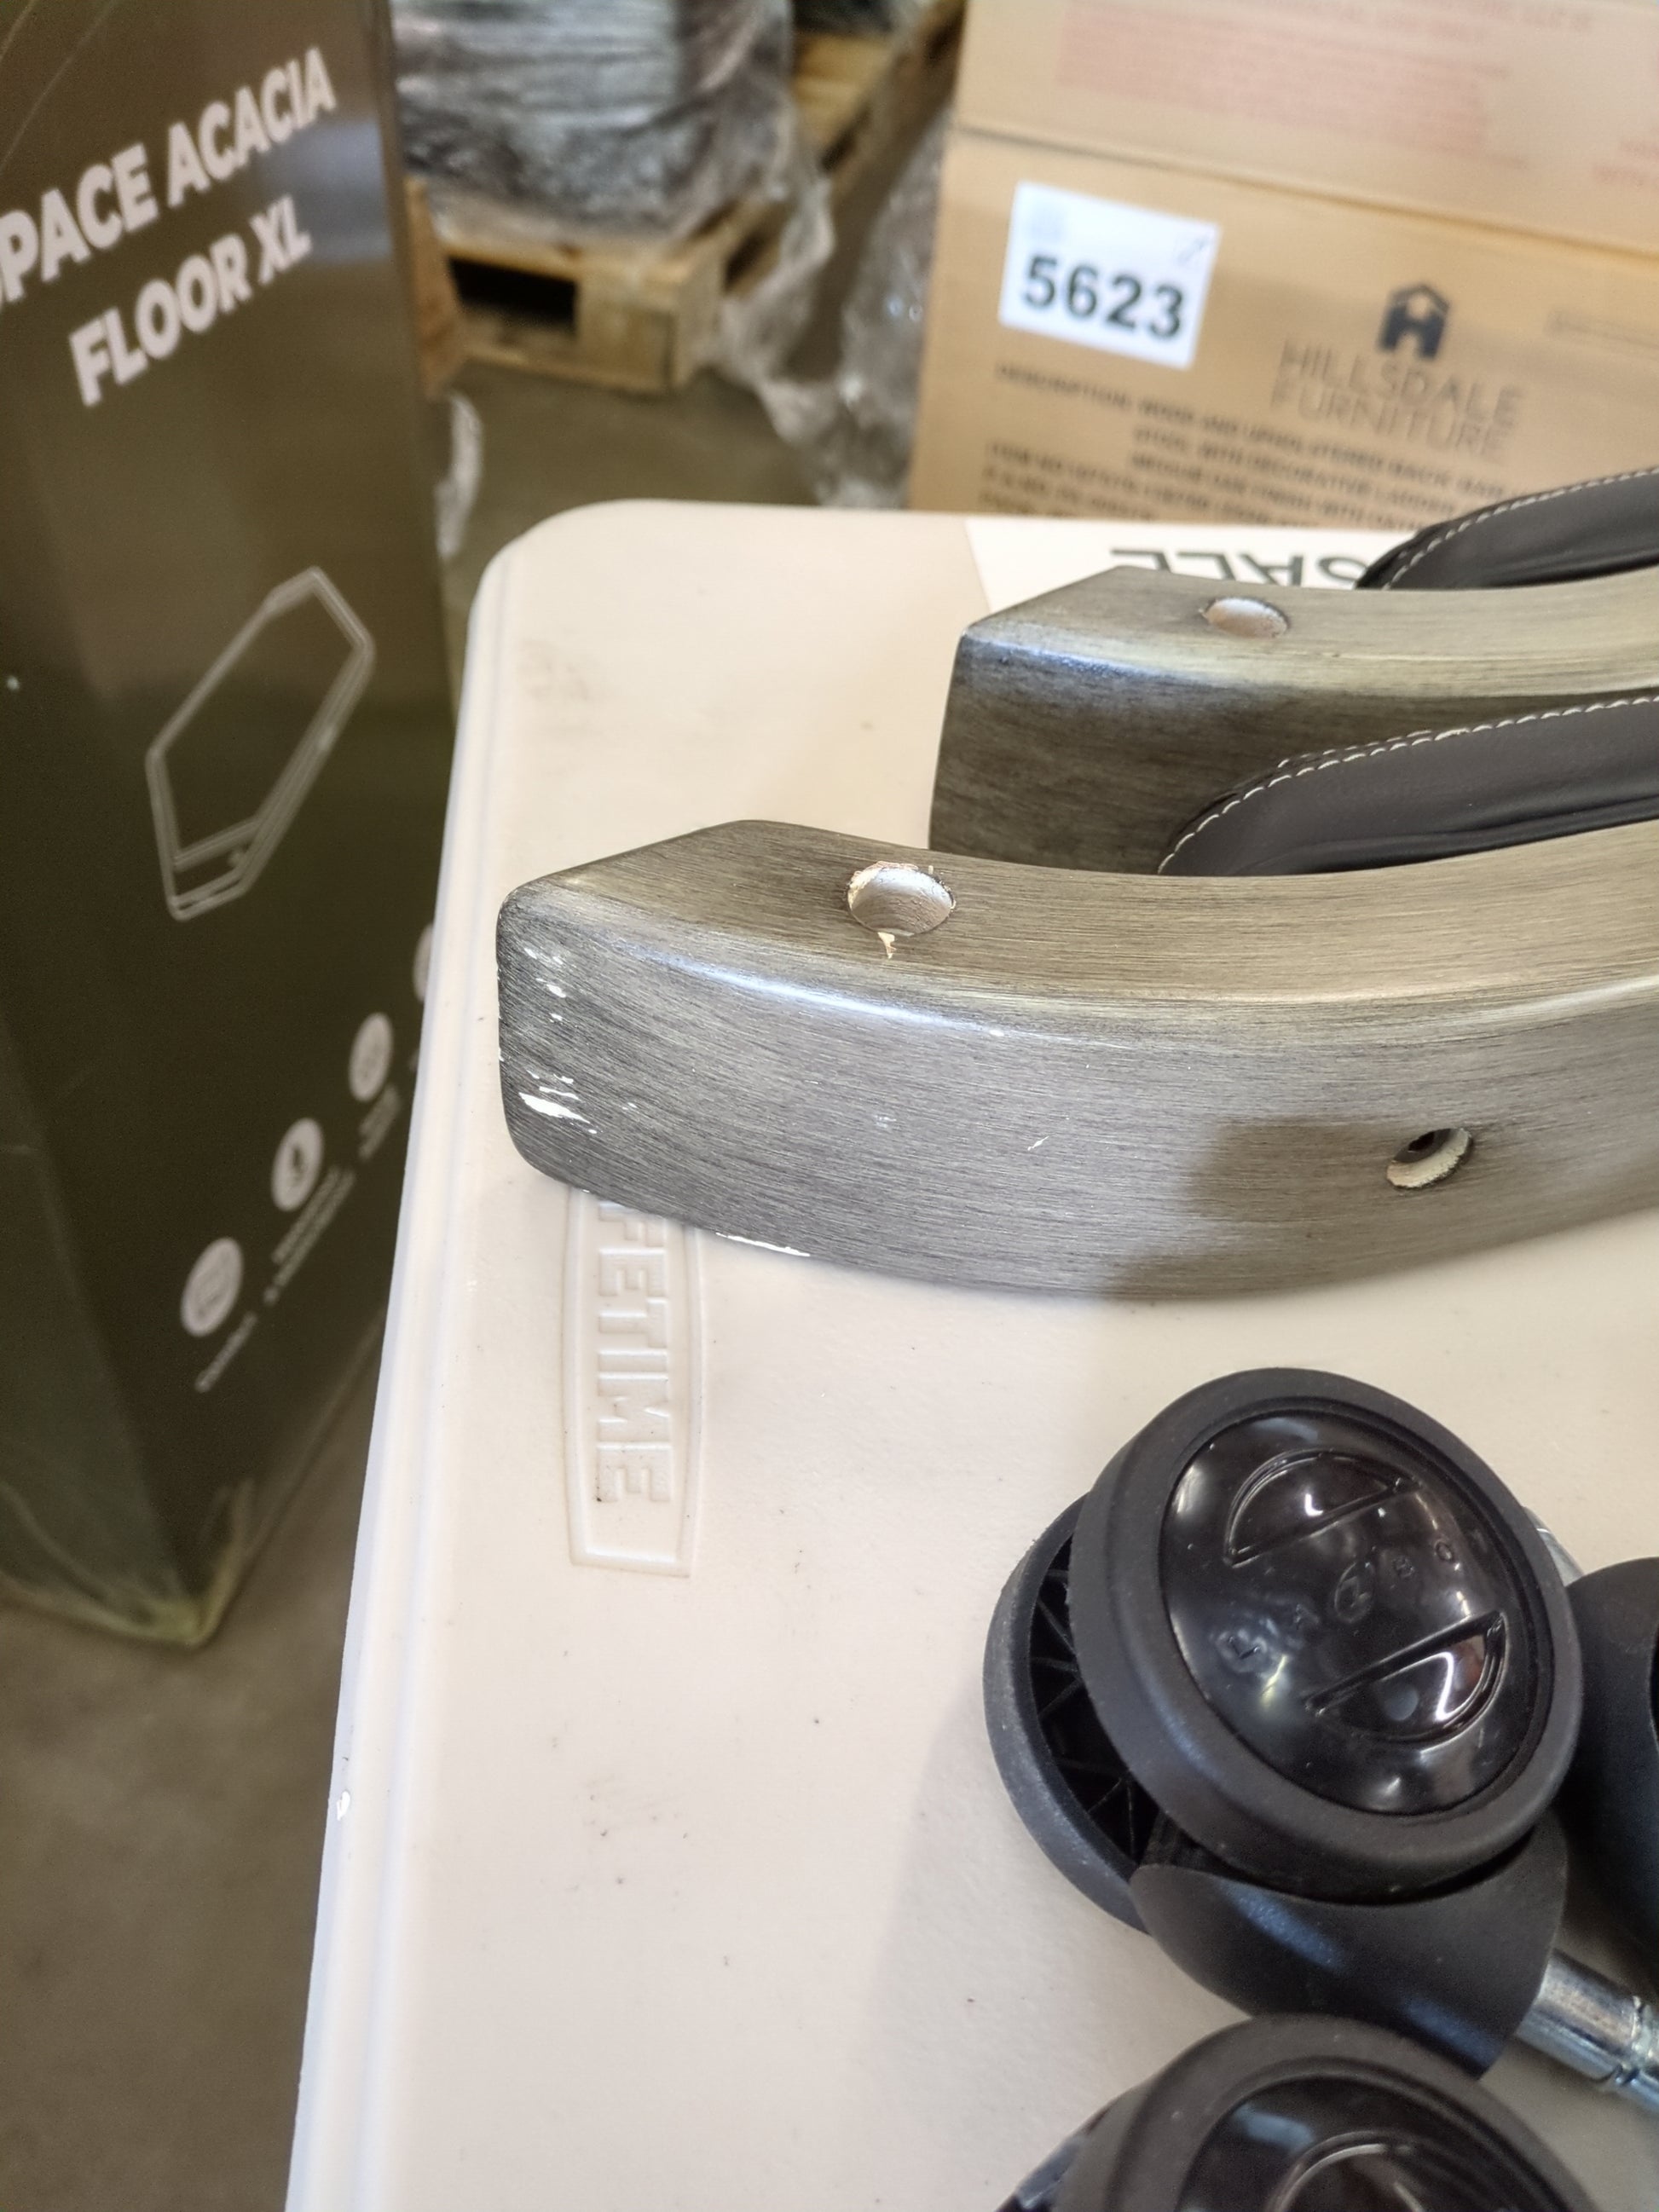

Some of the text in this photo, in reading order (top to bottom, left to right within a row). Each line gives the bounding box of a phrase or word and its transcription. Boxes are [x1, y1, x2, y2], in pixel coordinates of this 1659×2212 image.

[0, 47, 337, 304] PACE ACACIA
[69, 193, 313, 407] FLOOR XL
[1021, 255, 1184, 340] 5623
[1270, 379, 1515, 463] FURNITURE
[1278, 338, 1522, 429] HILLSDALE
[597, 1200, 673, 1502] FETIME
